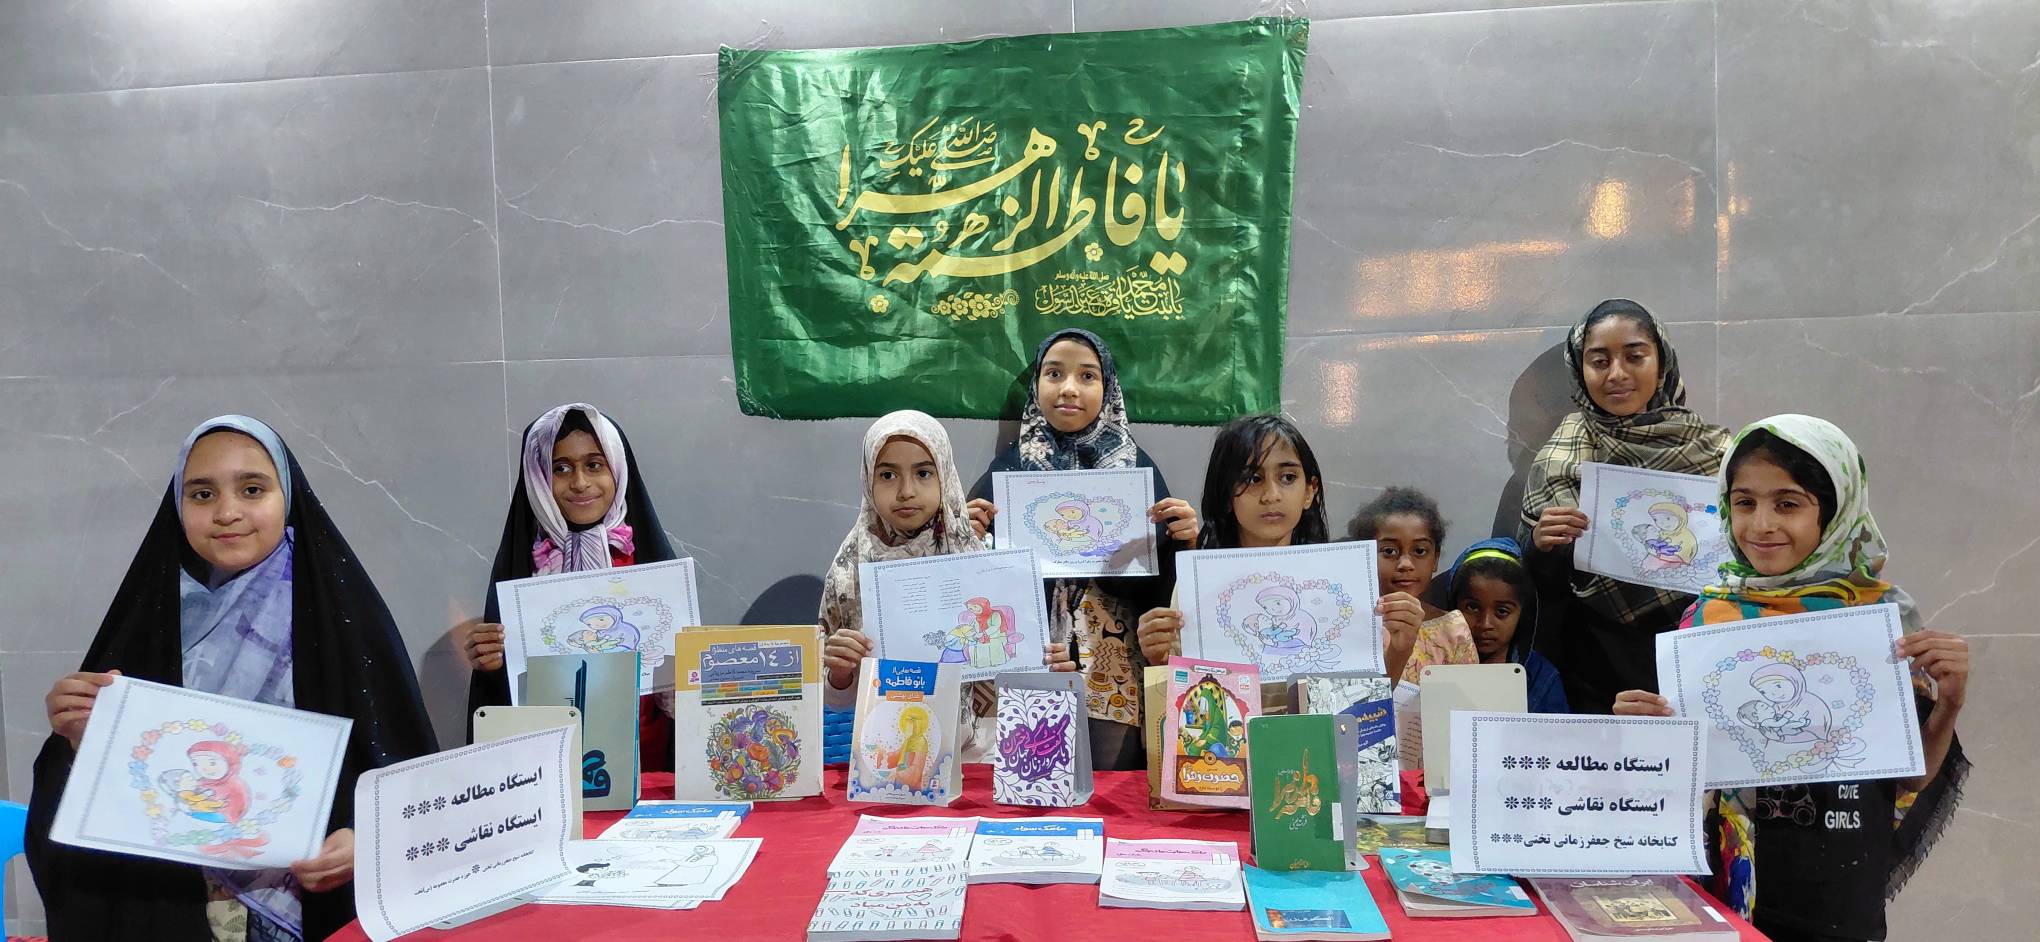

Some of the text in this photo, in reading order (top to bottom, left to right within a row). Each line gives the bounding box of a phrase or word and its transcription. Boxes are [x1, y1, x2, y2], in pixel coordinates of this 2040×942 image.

[885, 676, 926, 689] بانو فاطمه
[1556, 756, 1670, 776] ایستگاه مطالعه
[1183, 767, 1241, 784] حضرت زهرا
[451, 765, 543, 806] ایستگاه مطالعه
[1838, 784, 1859, 799] CUTE
[1558, 796, 1665, 816] ایستگاه نقاشی
[1825, 810, 1861, 829] GIRLS
[454, 806, 542, 853] ایستگاه نقاشی
[1523, 834, 1551, 848] تختی
[1613, 836, 1635, 849] شیخ
[1637, 835, 1679, 850] کتابخانه
[850, 887, 933, 897] همسری که
[886, 901, 912, 910] من
